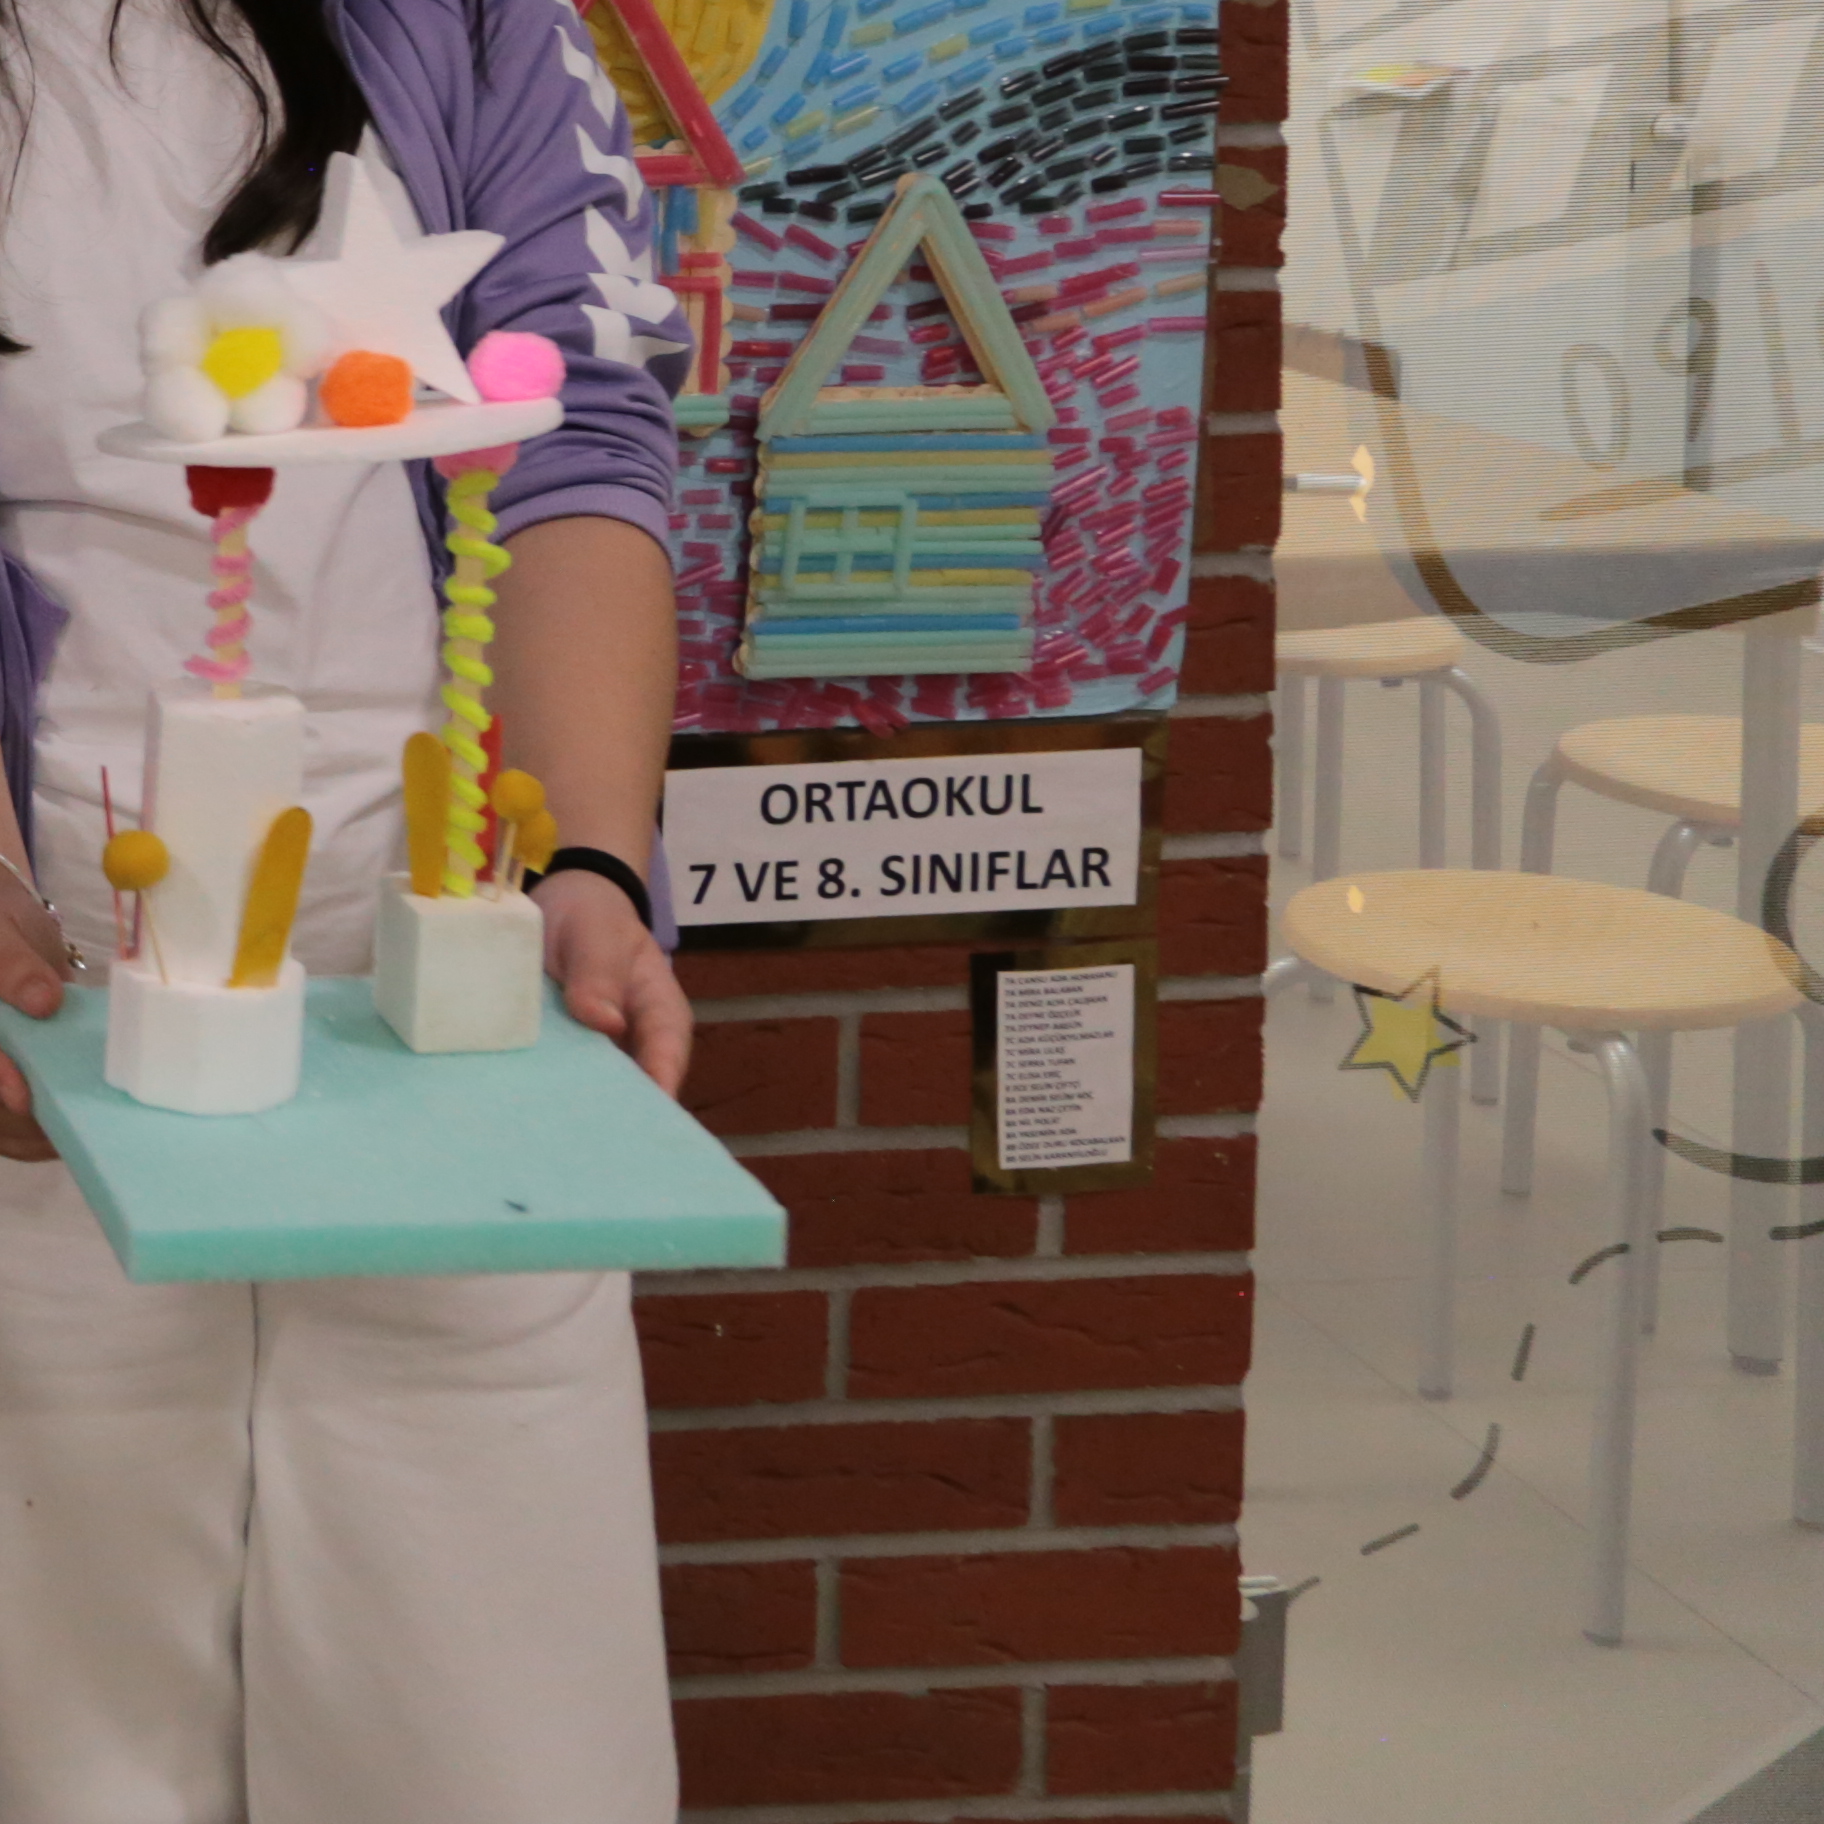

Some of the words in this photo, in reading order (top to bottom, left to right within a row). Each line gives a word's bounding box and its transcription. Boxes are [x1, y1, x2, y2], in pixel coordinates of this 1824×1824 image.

[759, 774, 1044, 825] ORTAOKUL
[689, 864, 716, 905] 7
[734, 861, 799, 903] VE
[817, 857, 860, 900] 8.
[880, 847, 1112, 897] SINIFLAR
